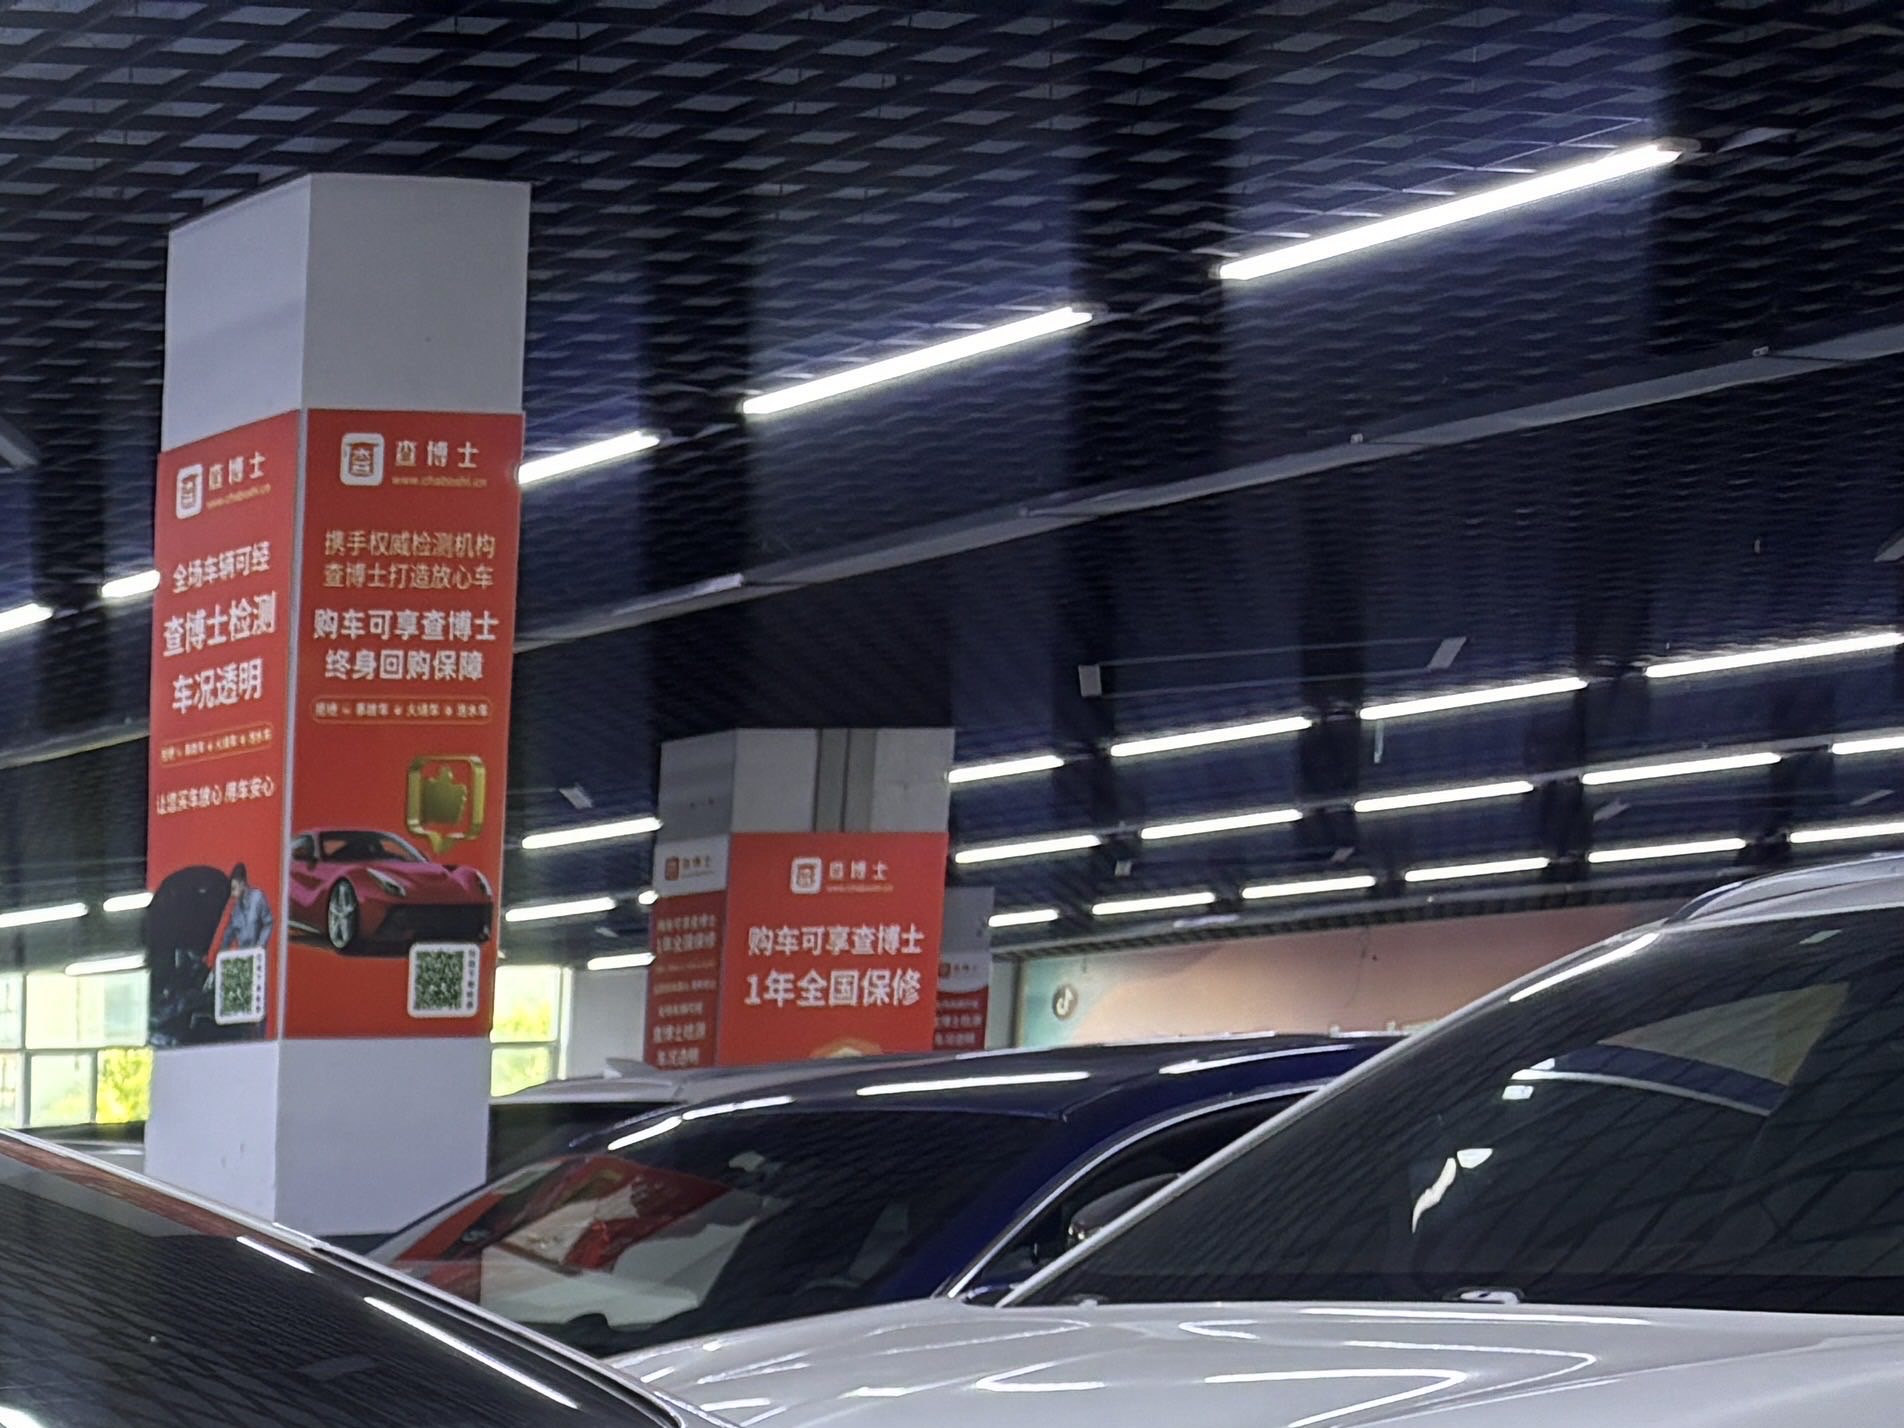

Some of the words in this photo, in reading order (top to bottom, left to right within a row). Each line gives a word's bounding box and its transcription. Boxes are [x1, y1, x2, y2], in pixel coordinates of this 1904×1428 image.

[395, 440, 480, 468] 查博士
[208, 452, 266, 490] 查博士
[325, 531, 495, 559] 携手权威检测机构
[323, 563, 494, 590] 查博士打造放心车
[163, 591, 276, 656] 查博士检测
[314, 609, 499, 641] 购车可享查博士
[325, 650, 483, 680] 终身回购保障
[172, 658, 263, 714] 车况透明
[748, 923, 925, 957] 购车可享查博士
[744, 968, 921, 1008] 1年全国保修
